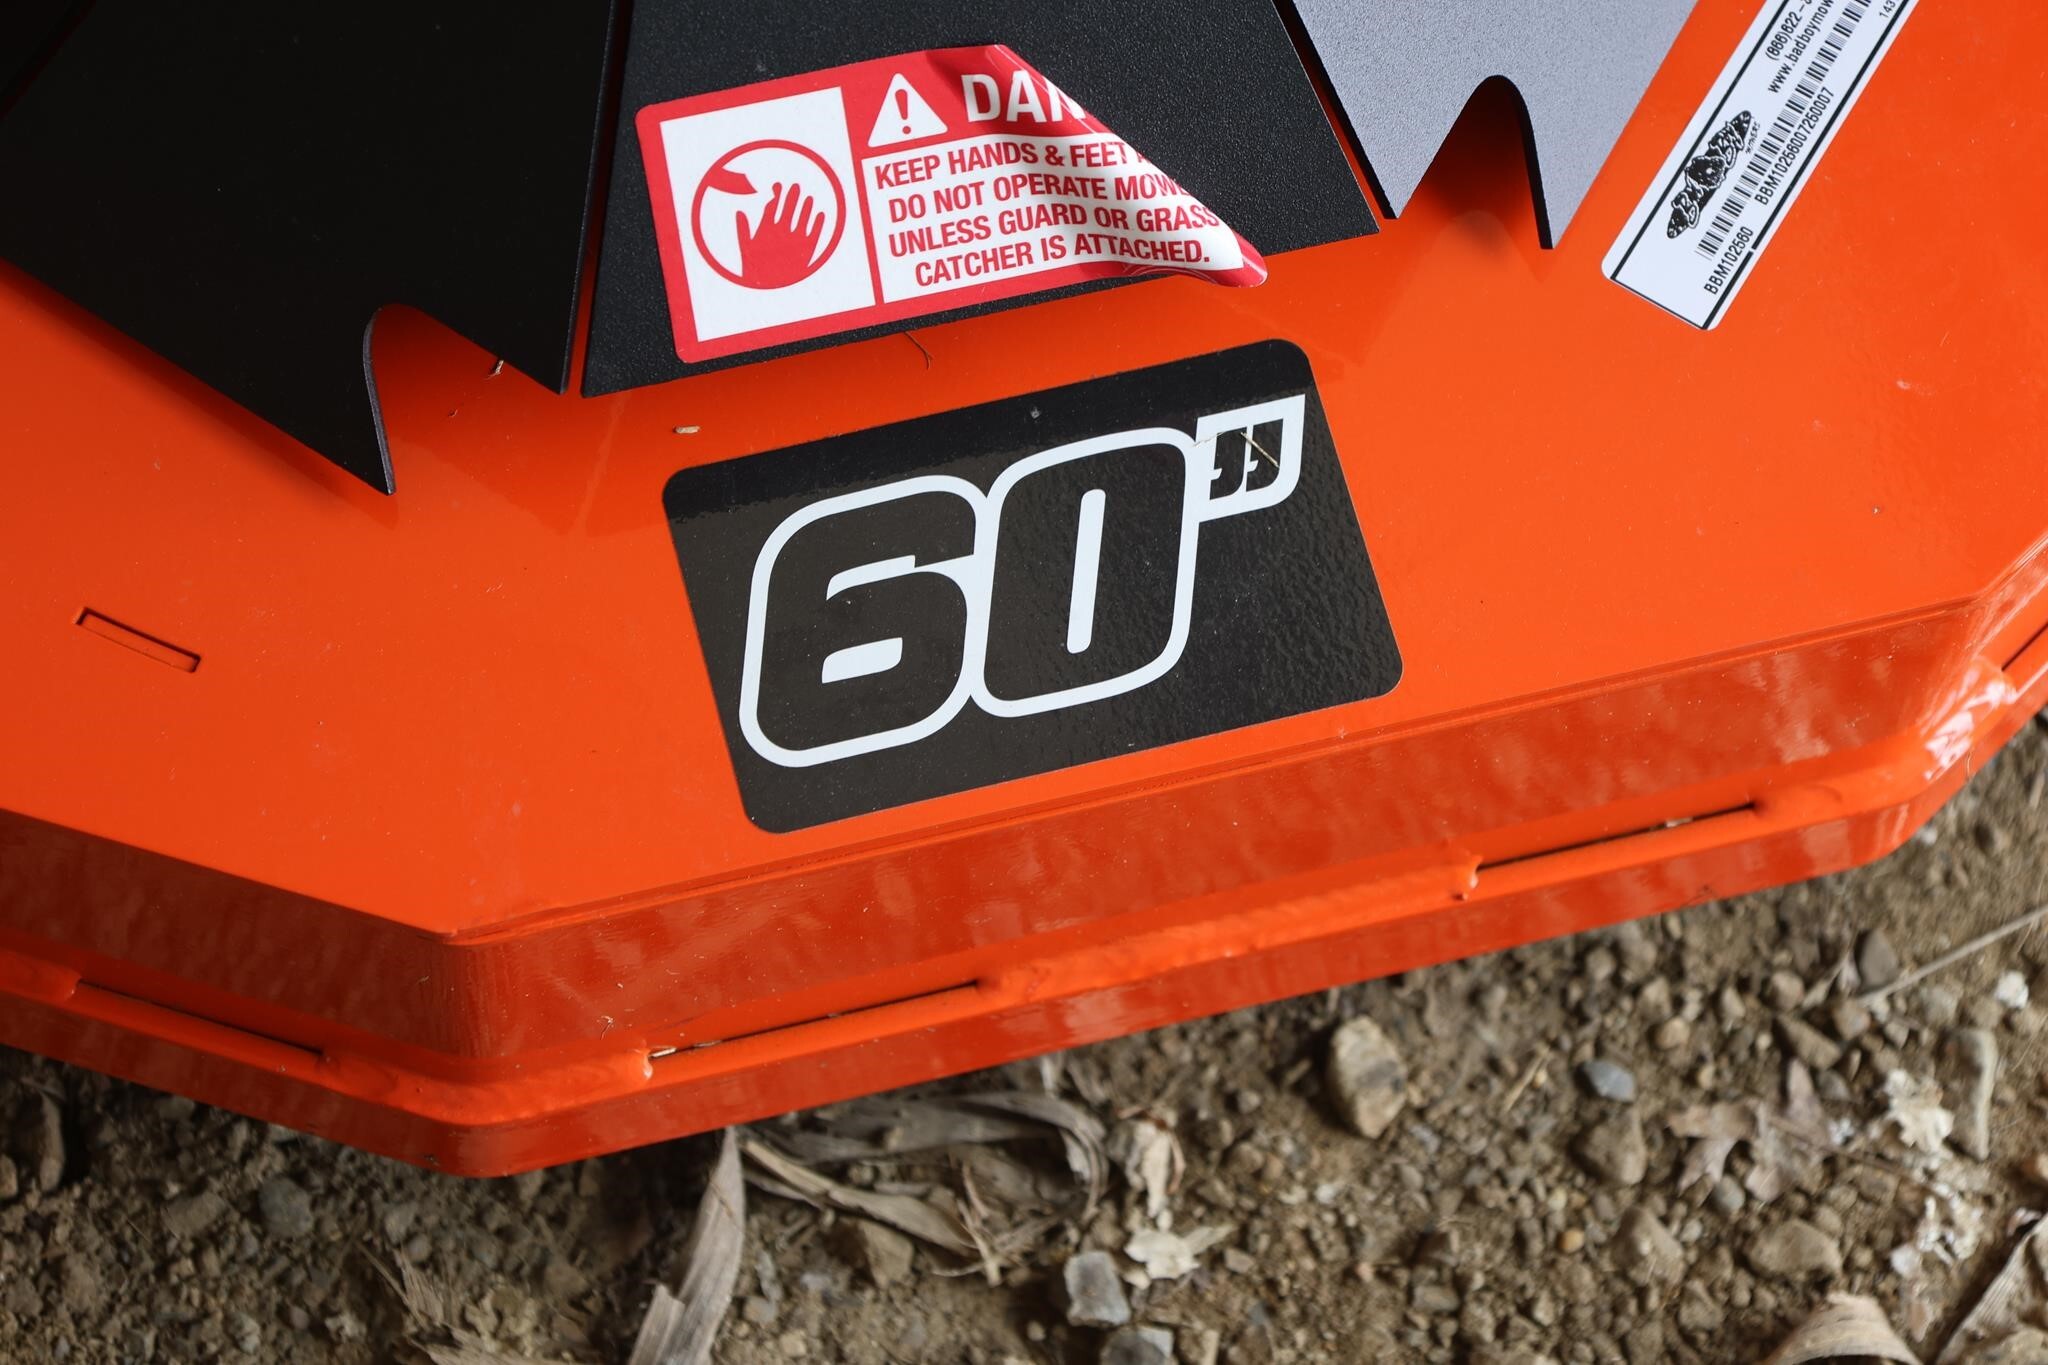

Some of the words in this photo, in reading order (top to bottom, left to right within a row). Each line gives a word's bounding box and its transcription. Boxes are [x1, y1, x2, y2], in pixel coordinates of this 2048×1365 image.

[875, 155, 941, 190] KEEP
[948, 142, 1038, 175] HANDS
[1045, 145, 1065, 167] &
[1070, 142, 1127, 167] FEET
[889, 194, 926, 223] DO
[933, 181, 985, 214] NOT
[993, 173, 1107, 201] OPERATE
[889, 215, 991, 257] UNLESS
[998, 203, 1087, 235] GUARD
[1094, 207, 1129, 230] OR
[1136, 205, 1220, 232] GRASS
[915, 242, 1033, 286] CATCHER
[1040, 235, 1066, 262] IS
[1075, 233, 1210, 262] ATTACHED.
[1703, 226, 1754, 295] BBM102560
